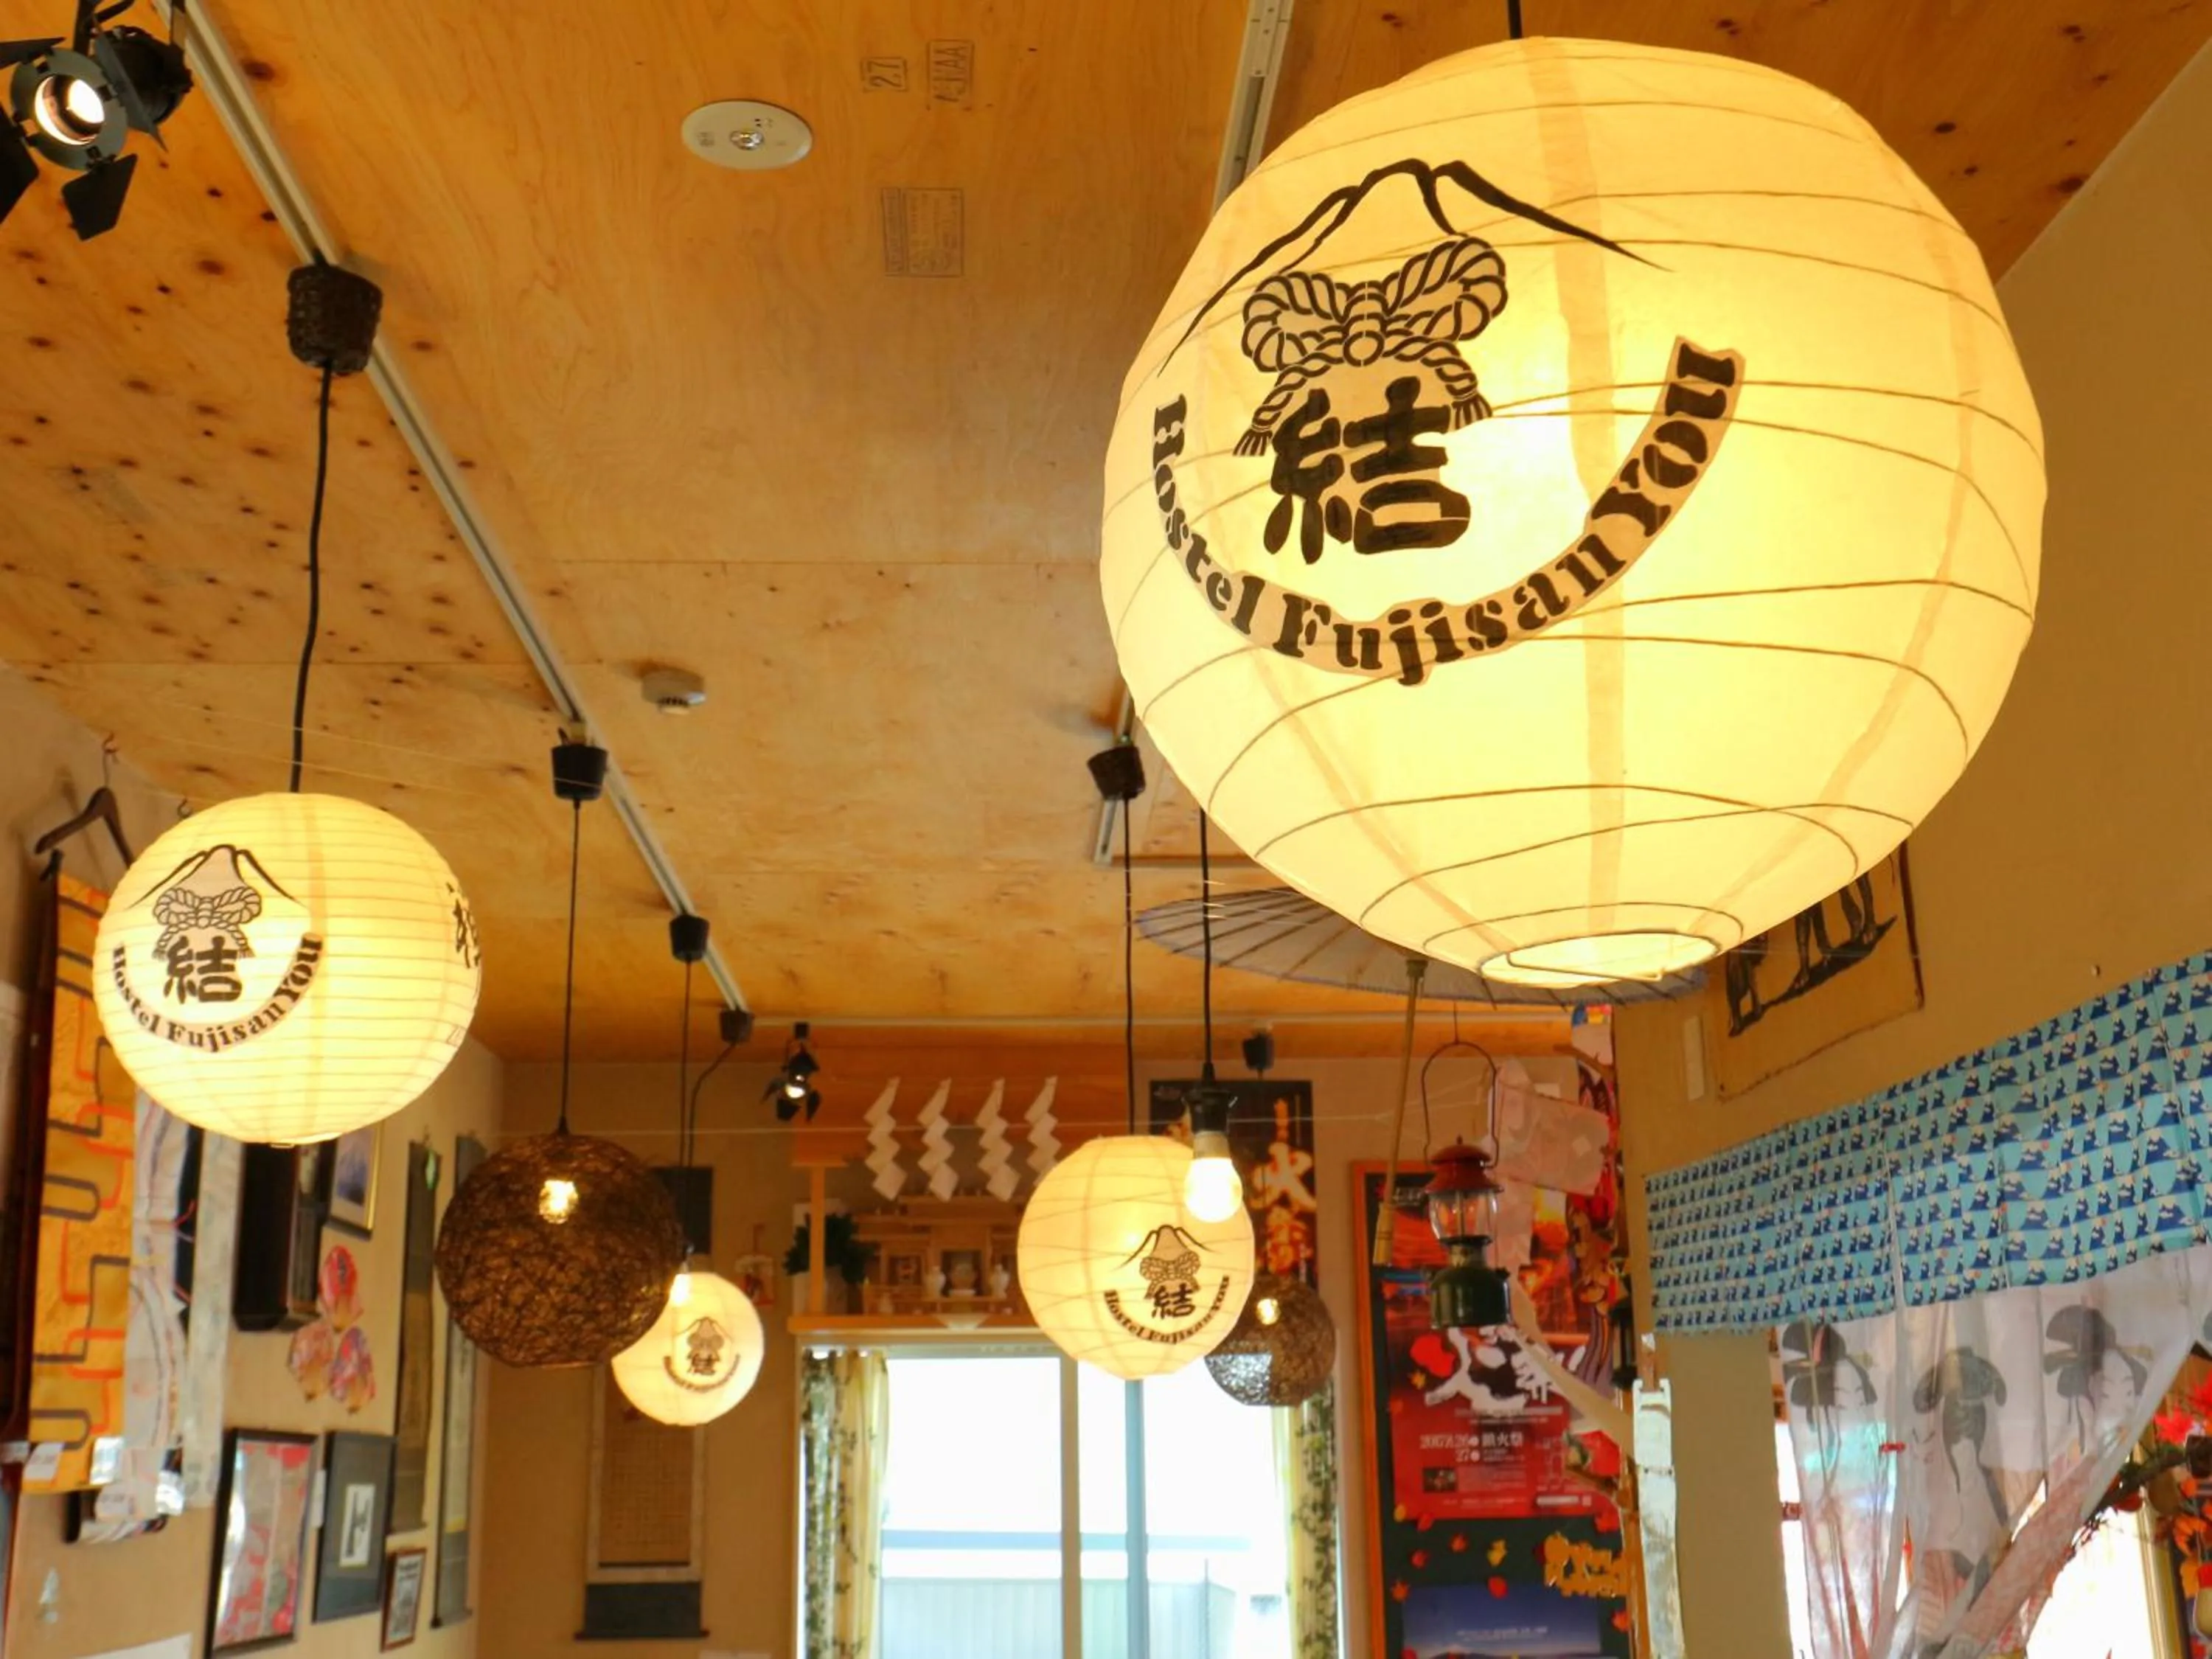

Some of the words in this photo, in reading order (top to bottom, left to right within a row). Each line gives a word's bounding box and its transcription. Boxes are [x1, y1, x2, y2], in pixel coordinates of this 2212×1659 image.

[1264, 377, 1470, 564] 結
[1154, 394, 1266, 636] Hostel
[1273, 534, 1627, 686] Fujisan
[113, 946, 161, 1032] Hostel
[167, 1003, 285, 1053] Fujisan
[164, 936, 242, 1004] 結
[1152, 1283, 1196, 1320] 結
